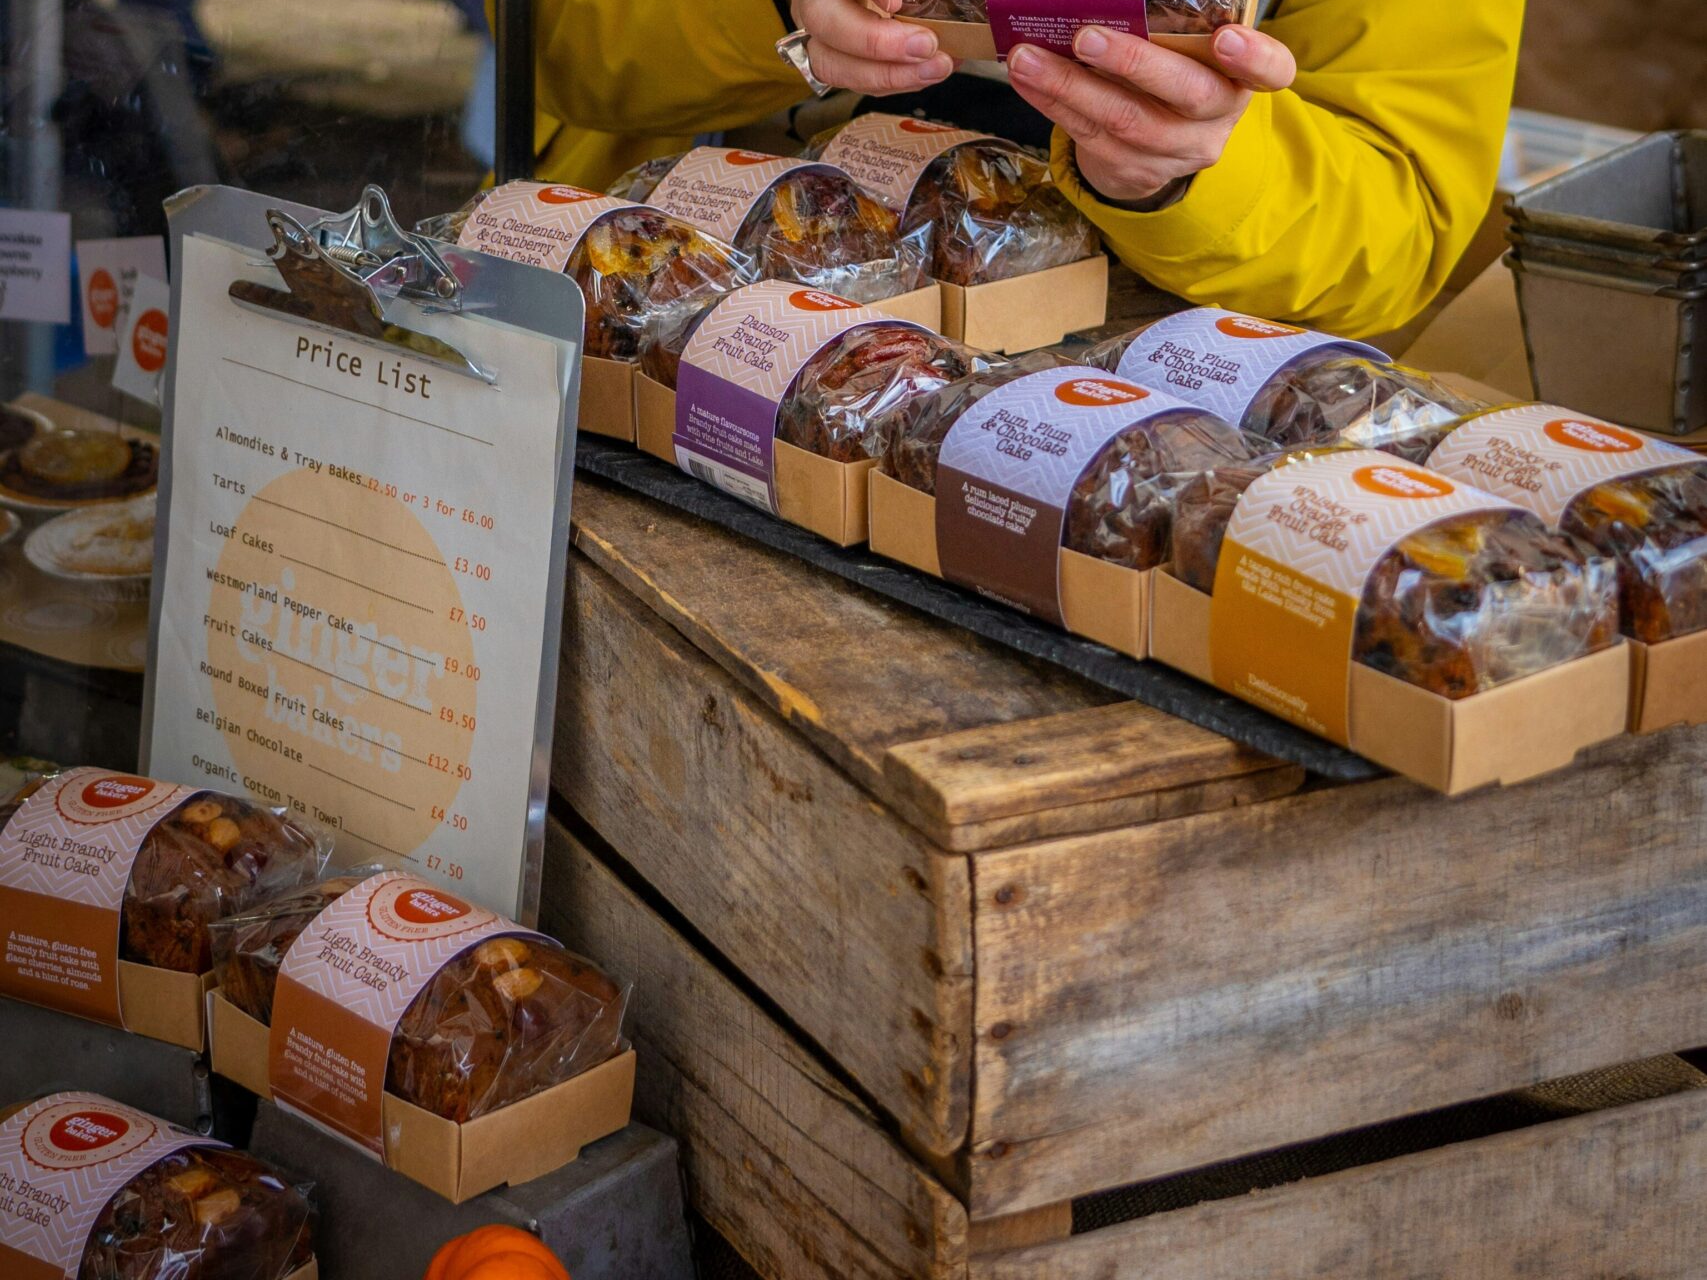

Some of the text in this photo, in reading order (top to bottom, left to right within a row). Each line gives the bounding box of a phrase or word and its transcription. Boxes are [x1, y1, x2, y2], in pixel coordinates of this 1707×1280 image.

[866, 168, 894, 186] Cake
[666, 188, 737, 213] & Cranberry
[693, 207, 721, 223] Cake
[476, 213, 573, 241] Gin, Clementine
[477, 228, 556, 257] & Cranberry
[730, 327, 777, 355] Brandy
[739, 314, 790, 343] Damson
[296, 336, 432, 399] Price List
[711, 336, 774, 372] Fruit Cake
[1147, 350, 1237, 386] & Chocolate
[1157, 340, 1241, 373] Rum, Plum
[1165, 368, 1204, 391] Cake
[690, 403, 696, 412] A
[981, 418, 1069, 457] & Chocolate
[990, 408, 1073, 444] Rum, Plum
[995, 438, 1034, 462] Cake
[1485, 435, 1546, 465] Whisky
[1543, 460, 1563, 472] &
[215, 426, 275, 456] Almondies
[280, 447, 290, 461] &
[294, 452, 323, 474] Tray
[367, 477, 398, 499] £2.50
[402, 492, 417, 504] or
[422, 495, 430, 509] 3
[435, 499, 456, 517] for
[462, 508, 494, 530] £6.00
[962, 481, 969, 492] A
[970, 485, 988, 499] rum
[1459, 452, 1543, 493] Fruit Cake
[212, 473, 491, 581] Tarts £3.00
[967, 505, 1005, 526] chocolate
[1267, 503, 1349, 552] Fruit Cake
[1350, 512, 1369, 525] &
[209, 521, 486, 631] Loaf Cakes £7.50
[206, 567, 481, 681] Westmorland Pepper Cake £9.00
[236, 567, 445, 711] ginger
[203, 614, 476, 732] Fruit Cakes £9.50
[200, 661, 472, 782] Round Boxed Fruit Cakes £12.50
[265, 662, 403, 773] bakers
[94, 780, 146, 794] ginger
[196, 707, 468, 831] Belgian Chocolate £4.50
[192, 754, 464, 880] Organic Cotton Tea Towel £7.50
[18, 828, 119, 864] Light Brandy
[21, 846, 101, 877] Fruit Cake
[7, 941, 100, 972] Brandy fruit cake with
[9, 930, 17, 940] A
[51, 940, 79, 955] gluten
[80, 946, 98, 959] free
[319, 926, 410, 982] Light Brandy
[315, 944, 388, 993] Fruit Cake
[64, 1126, 98, 1144] bakers
[65, 1116, 118, 1139] ginger
[16, 1179, 71, 1215] Brandy
[16, 1200, 52, 1228] Cake
